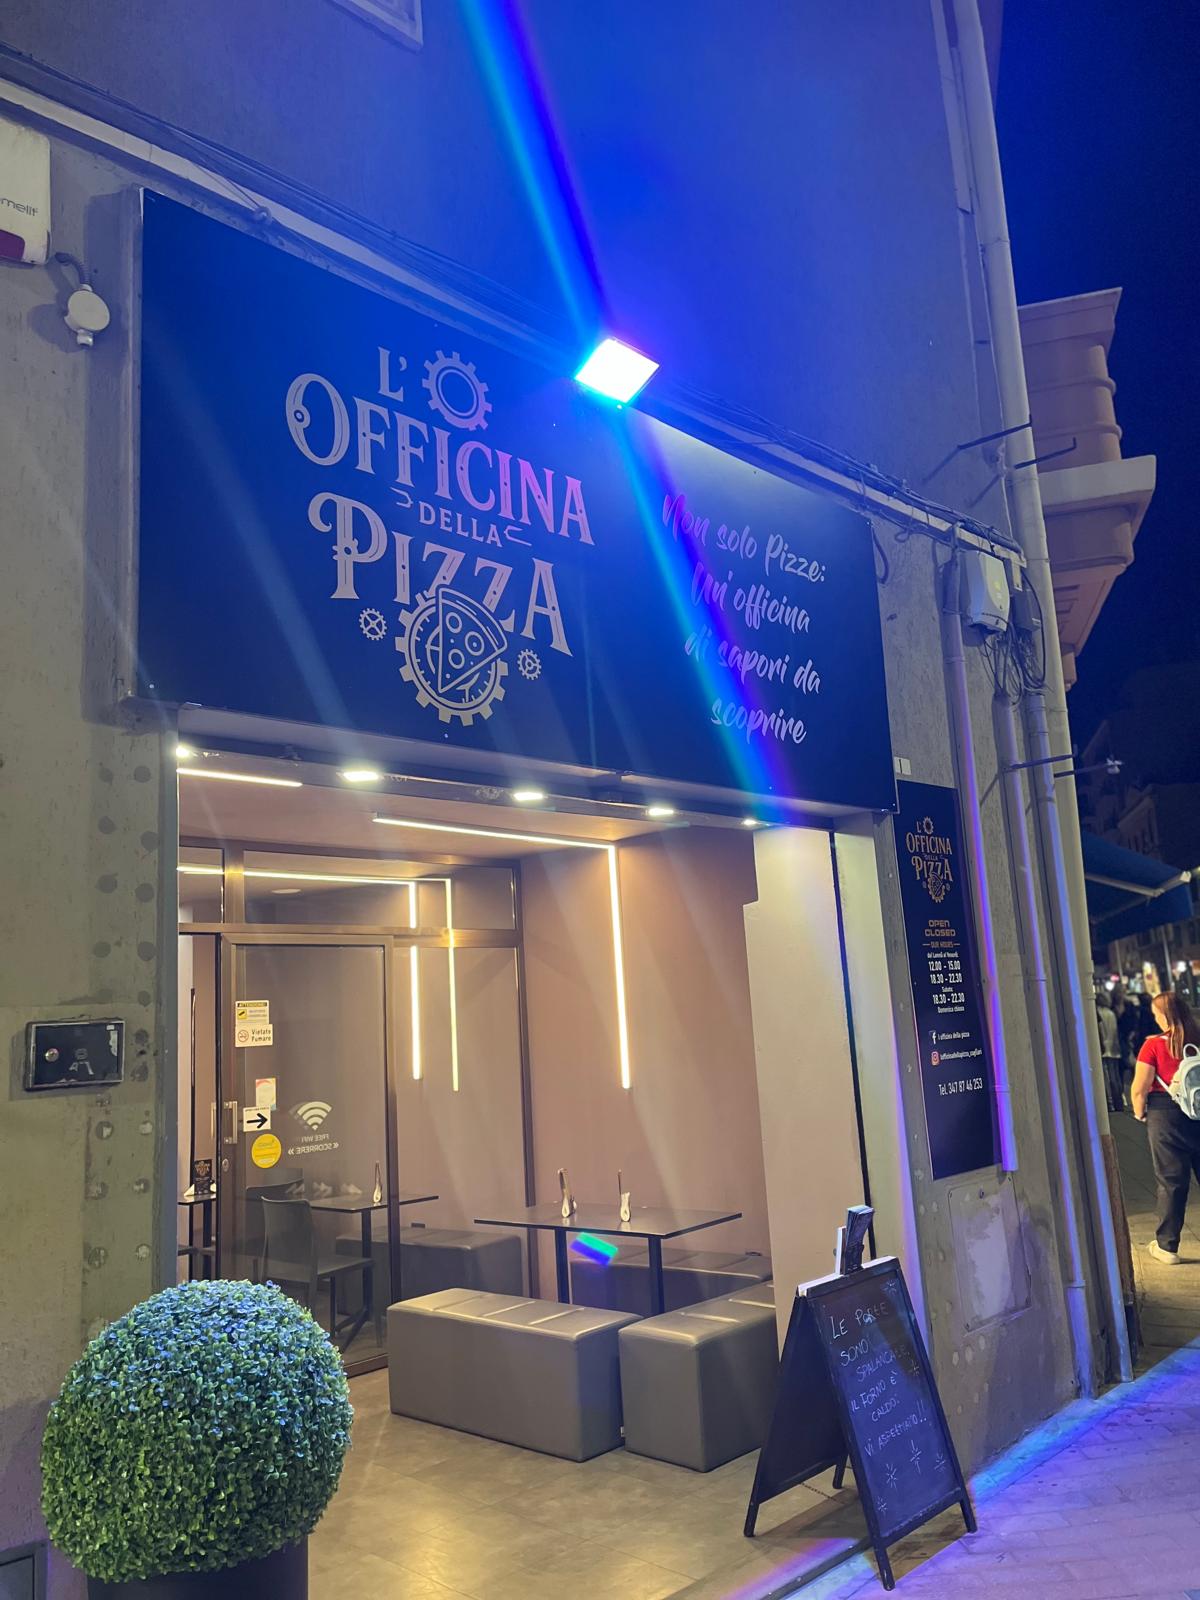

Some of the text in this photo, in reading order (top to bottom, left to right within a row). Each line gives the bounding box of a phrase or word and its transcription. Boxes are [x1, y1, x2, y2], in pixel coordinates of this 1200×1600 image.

[377, 346, 407, 402] L'
[285, 373, 595, 546] OFFICINA
[418, 501, 503, 548] DELLA
[662, 493, 710, 546] Non
[716, 523, 758, 560] solo
[307, 491, 573, 657] PIZZA
[733, 584, 810, 634] officina
[684, 624, 821, 695] di sapori da
[710, 698, 807, 744] scoprire
[905, 832, 953, 855] OFFICINA
[911, 855, 954, 882] PIZZA
[924, 928, 957, 937] CLOSED
[928, 919, 950, 928] OPEN
[928, 960, 942, 972] 12.00
[947, 960, 961, 971] 15.00
[930, 973, 944, 985] 18.30
[948, 972, 963, 984] 22.30
[932, 994, 947, 1005] 18.30
[950, 992, 965, 1004] 22.30
[948, 1081, 958, 1095] 347
[958, 1080, 965, 1093] 87
[972, 1077, 983, 1090] 253
[830, 1315, 848, 1339] LE
